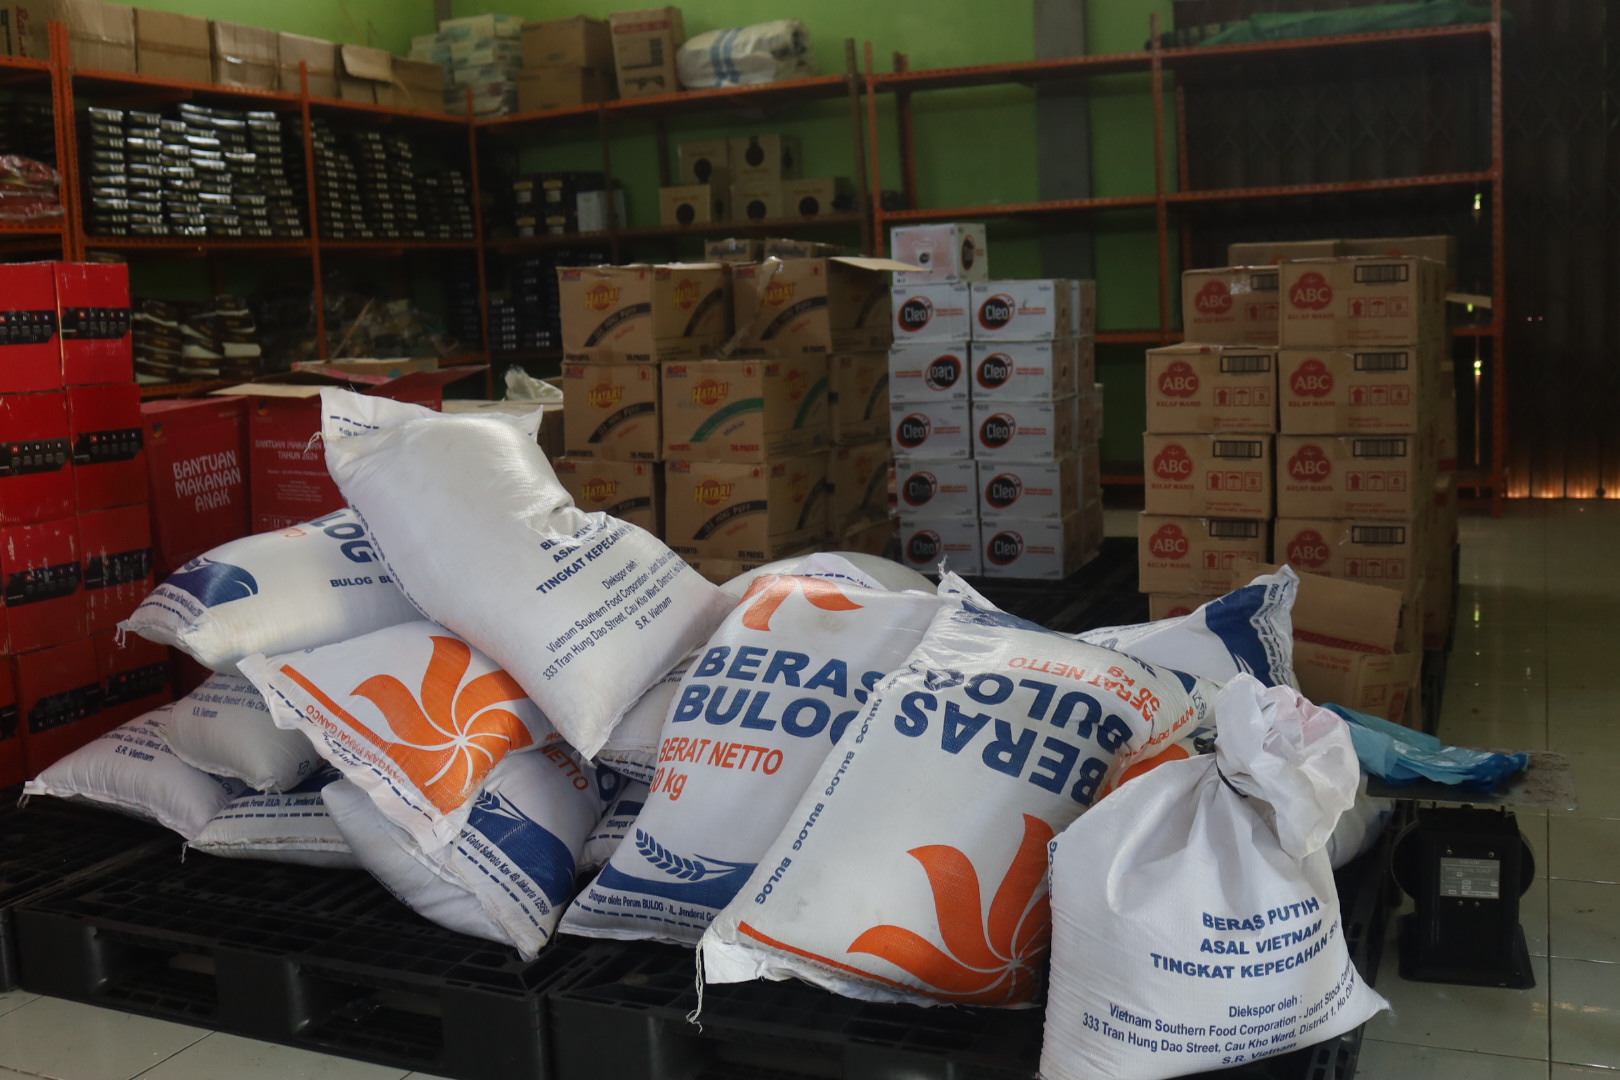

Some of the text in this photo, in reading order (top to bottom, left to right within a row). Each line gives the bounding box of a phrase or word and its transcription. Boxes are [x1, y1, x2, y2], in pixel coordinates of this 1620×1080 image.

[1198, 294, 1229, 308] ABC
[1293, 287, 1329, 302] ABC
[904, 307, 927, 322] Cleo
[984, 306, 1009, 321] Cleo
[932, 366, 954, 381] Cleo
[983, 366, 1007, 380] Cleo
[1162, 376, 1196, 390] ABC
[1293, 375, 1330, 390] ABC
[902, 424, 925, 439] Cleo
[985, 424, 1009, 439] Cleo
[172, 450, 237, 479] BANTUAN
[1156, 459, 1190, 474] ABC
[1292, 460, 1327, 475] ABC
[174, 468, 242, 499] MAKANAN
[694, 483, 733, 504] HATARI
[992, 483, 1016, 499] Cleo
[195, 488, 231, 513] ANAK
[912, 541, 935, 556] Cleo
[994, 541, 1017, 556] Cleo
[1153, 539, 1185, 553] ABC
[1291, 545, 1326, 560] ABC
[329, 576, 373, 588] BULOG
[536, 557, 586, 595] TINGKAT
[601, 567, 627, 590] Diekspor
[546, 627, 579, 653] Vietnam
[574, 606, 608, 630] Southern
[606, 593, 623, 612] Food
[619, 572, 649, 602] Corporation
[635, 595, 673, 630] S.R. Vietnam
[542, 664, 559, 681] 333
[554, 650, 575, 669] Tran
[571, 635, 595, 656] Hung
[594, 626, 608, 641] Dao
[623, 603, 638, 616] Cau
[636, 593, 649, 607] Kho
[659, 571, 673, 588] District
[693, 645, 886, 706] BERAS
[1008, 657, 1086, 680] NETTO
[1087, 673, 1154, 721] BERAT
[1138, 687, 1161, 712] 50
[305, 704, 338, 735] GANCO
[128, 748, 155, 762] Vietnam
[338, 729, 365, 756] PAKAI
[894, 690, 1108, 807] BERAS
[365, 750, 405, 784] JANGAN
[658, 737, 784, 776] BERAT NETTO
[661, 766, 689, 801] kg
[825, 751, 856, 796] BULOG
[792, 802, 825, 851] BULOG
[466, 830, 483, 852] Gatot
[481, 846, 502, 868] Subroto
[498, 860, 511, 877] Kav
[516, 876, 535, 900] Jakarta
[754, 856, 792, 905] BULOG
[622, 896, 642, 909] Perum
[642, 896, 664, 912] BULOG
[678, 906, 705, 921] Jenderal
[1202, 896, 1320, 932] BERAS PUTIH
[1200, 918, 1323, 955] ASAL VIETNAM
[1149, 952, 1235, 980] TINGKAT
[1240, 935, 1329, 979] KEPECAHAN
[1109, 980, 1341, 1040] Vietnam Southern Food Corporation Joint Stock
[1228, 995, 1299, 1019] Diekspor oleh
[1082, 1012, 1101, 1032] 333
[1101, 1021, 1126, 1043] Tran
[1127, 1030, 1159, 1053] Hung
[1160, 1039, 1184, 1053] Dao
[1185, 1040, 1222, 1055] Street,
[1224, 1038, 1247, 1052] Cau
[1248, 1034, 1269, 1049] Kho
[1298, 1014, 1329, 1036] District
[1337, 996, 1346, 1011] Ho
[1221, 1042, 1298, 1066] S.R. Vietnam
